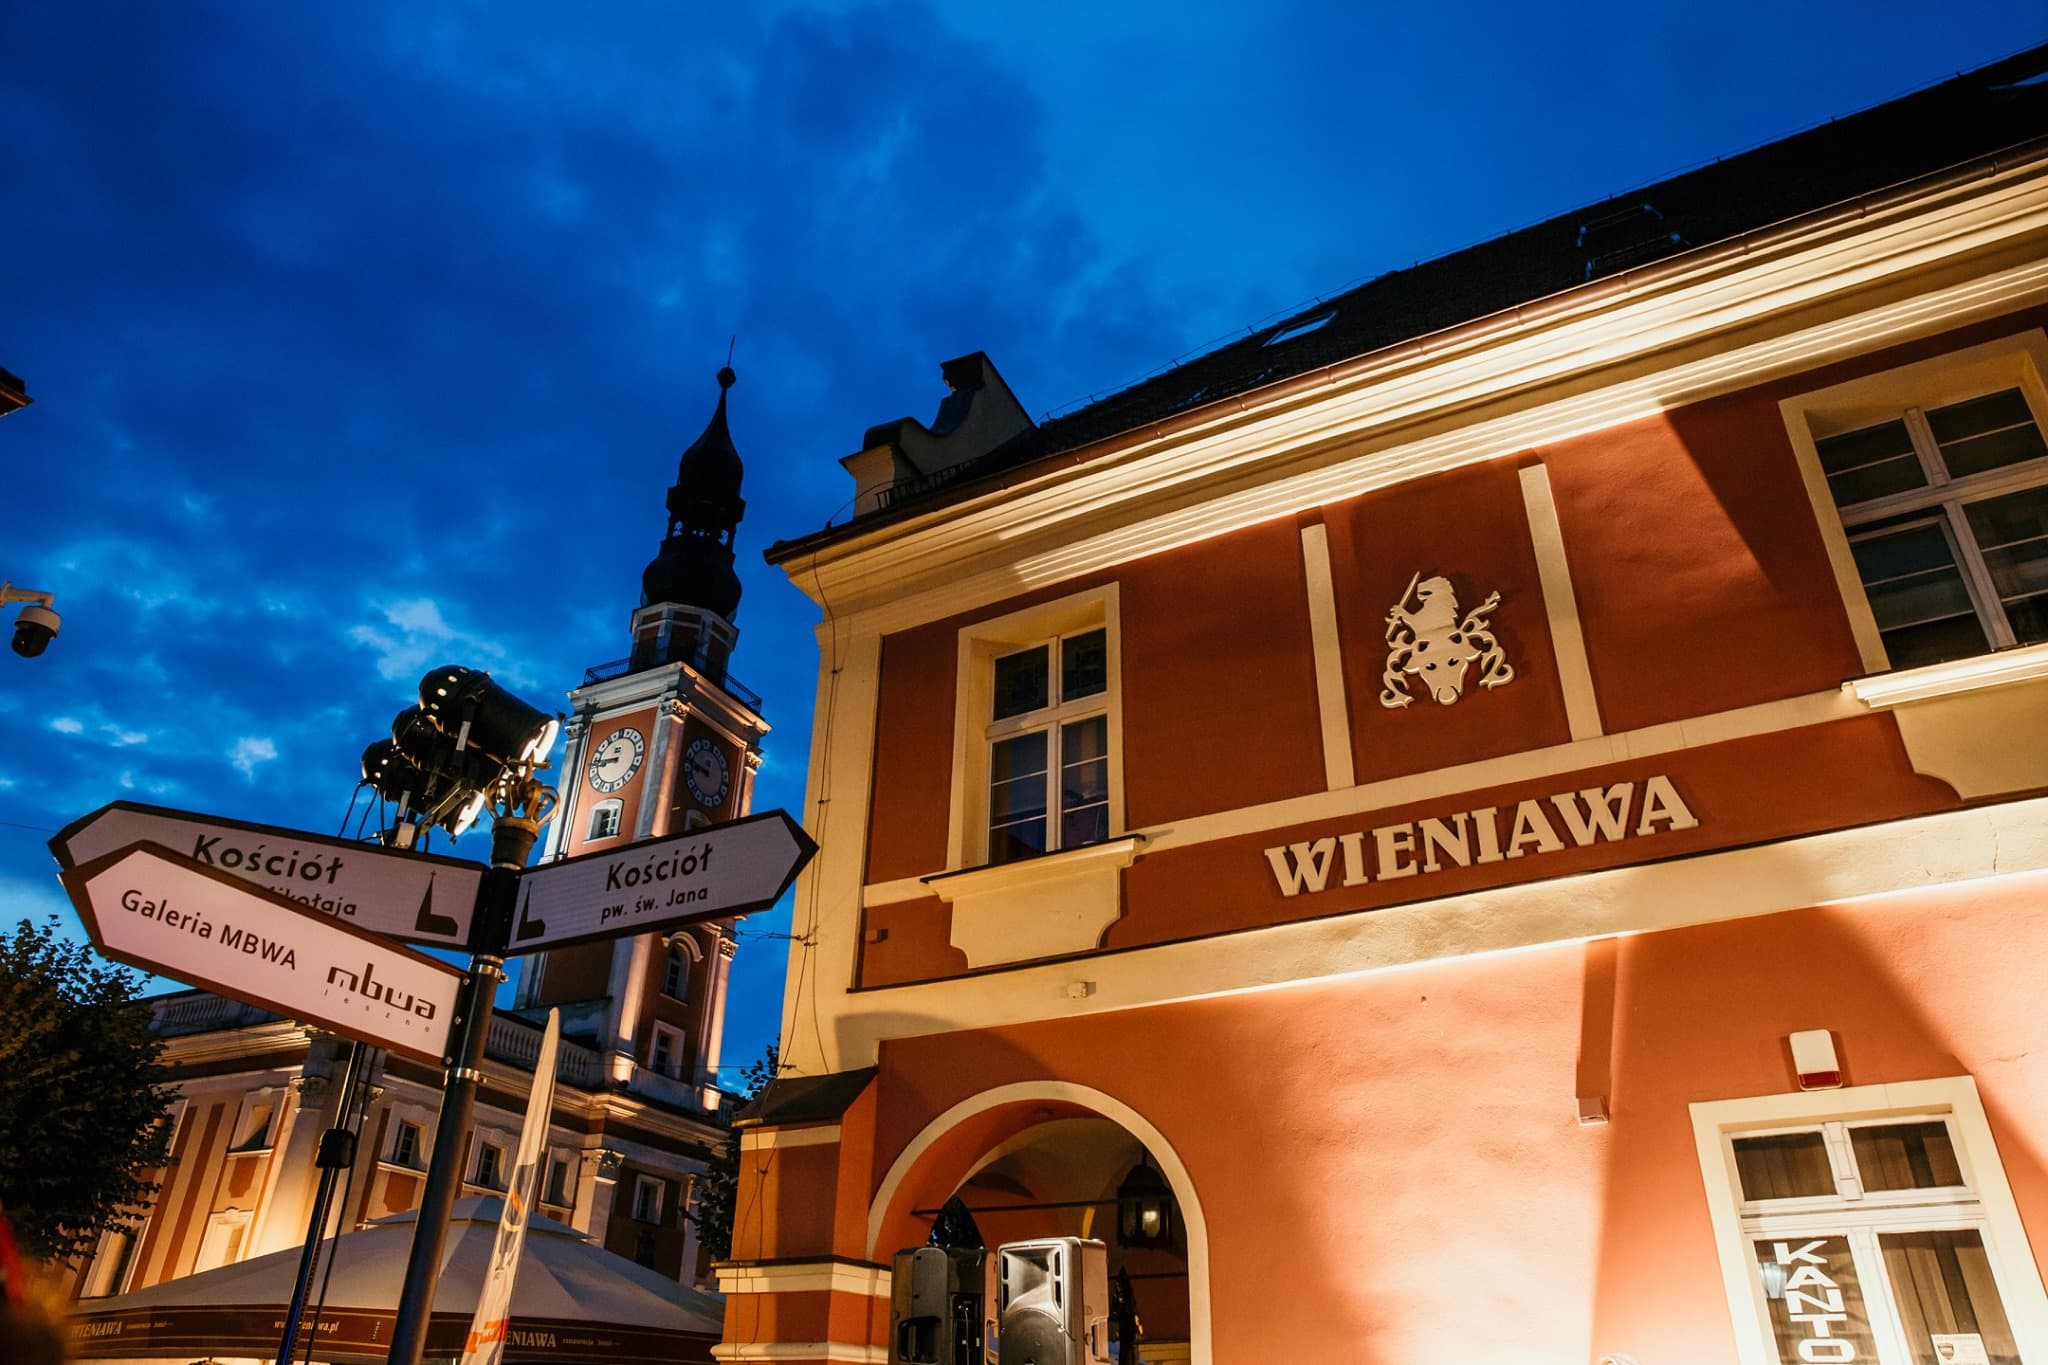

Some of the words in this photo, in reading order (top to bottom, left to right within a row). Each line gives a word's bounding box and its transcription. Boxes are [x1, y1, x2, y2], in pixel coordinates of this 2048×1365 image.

[191, 834, 343, 884] Kościół
[1264, 774, 1699, 897] WIENIAWA
[606, 843, 712, 891] Kościół
[121, 889, 212, 939] Galeria
[219, 924, 296, 970] MBWA
[600, 904, 628, 925] pw.
[634, 896, 659, 913] św.
[666, 887, 708, 907] Jana
[1773, 1240, 1856, 1365] KANTO
[505, 1329, 557, 1348] ENIAWA
